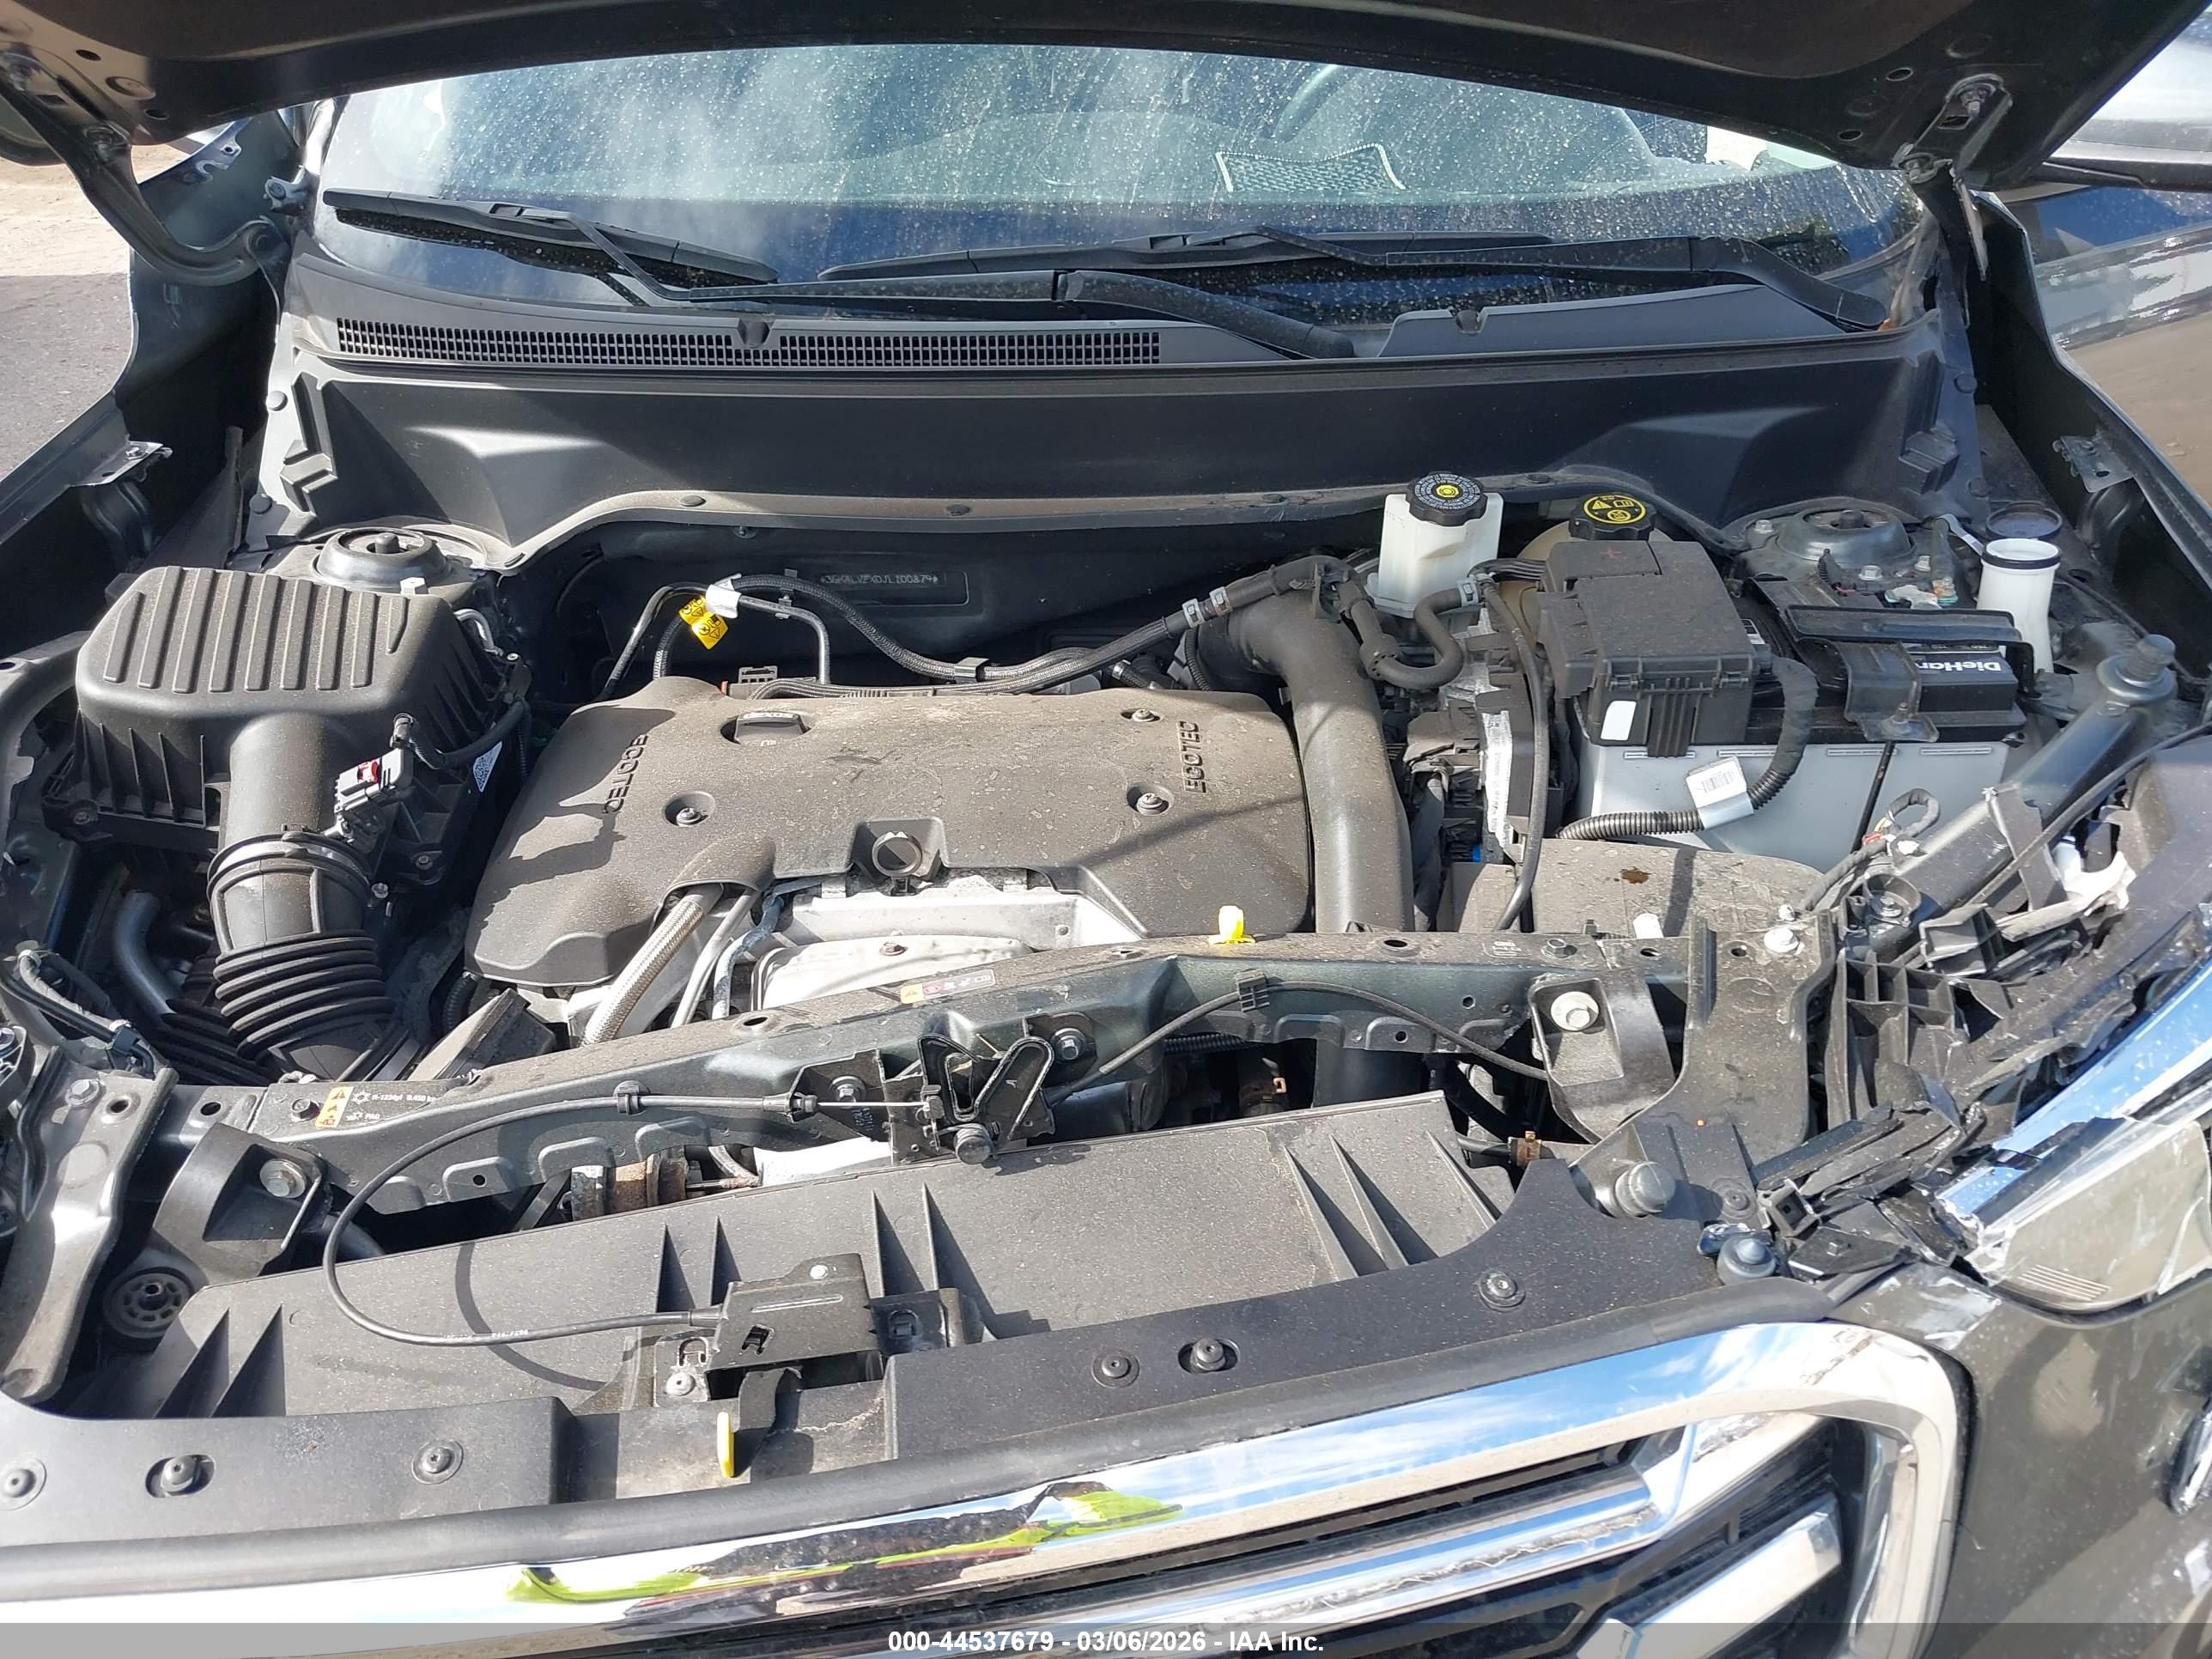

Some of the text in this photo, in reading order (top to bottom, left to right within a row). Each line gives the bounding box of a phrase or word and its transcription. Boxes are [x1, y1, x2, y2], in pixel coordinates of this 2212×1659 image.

[1915, 661, 2002, 672] DieHar
[603, 734, 649, 814] ECOTEC
[1176, 720, 1207, 793] ECOTEC
